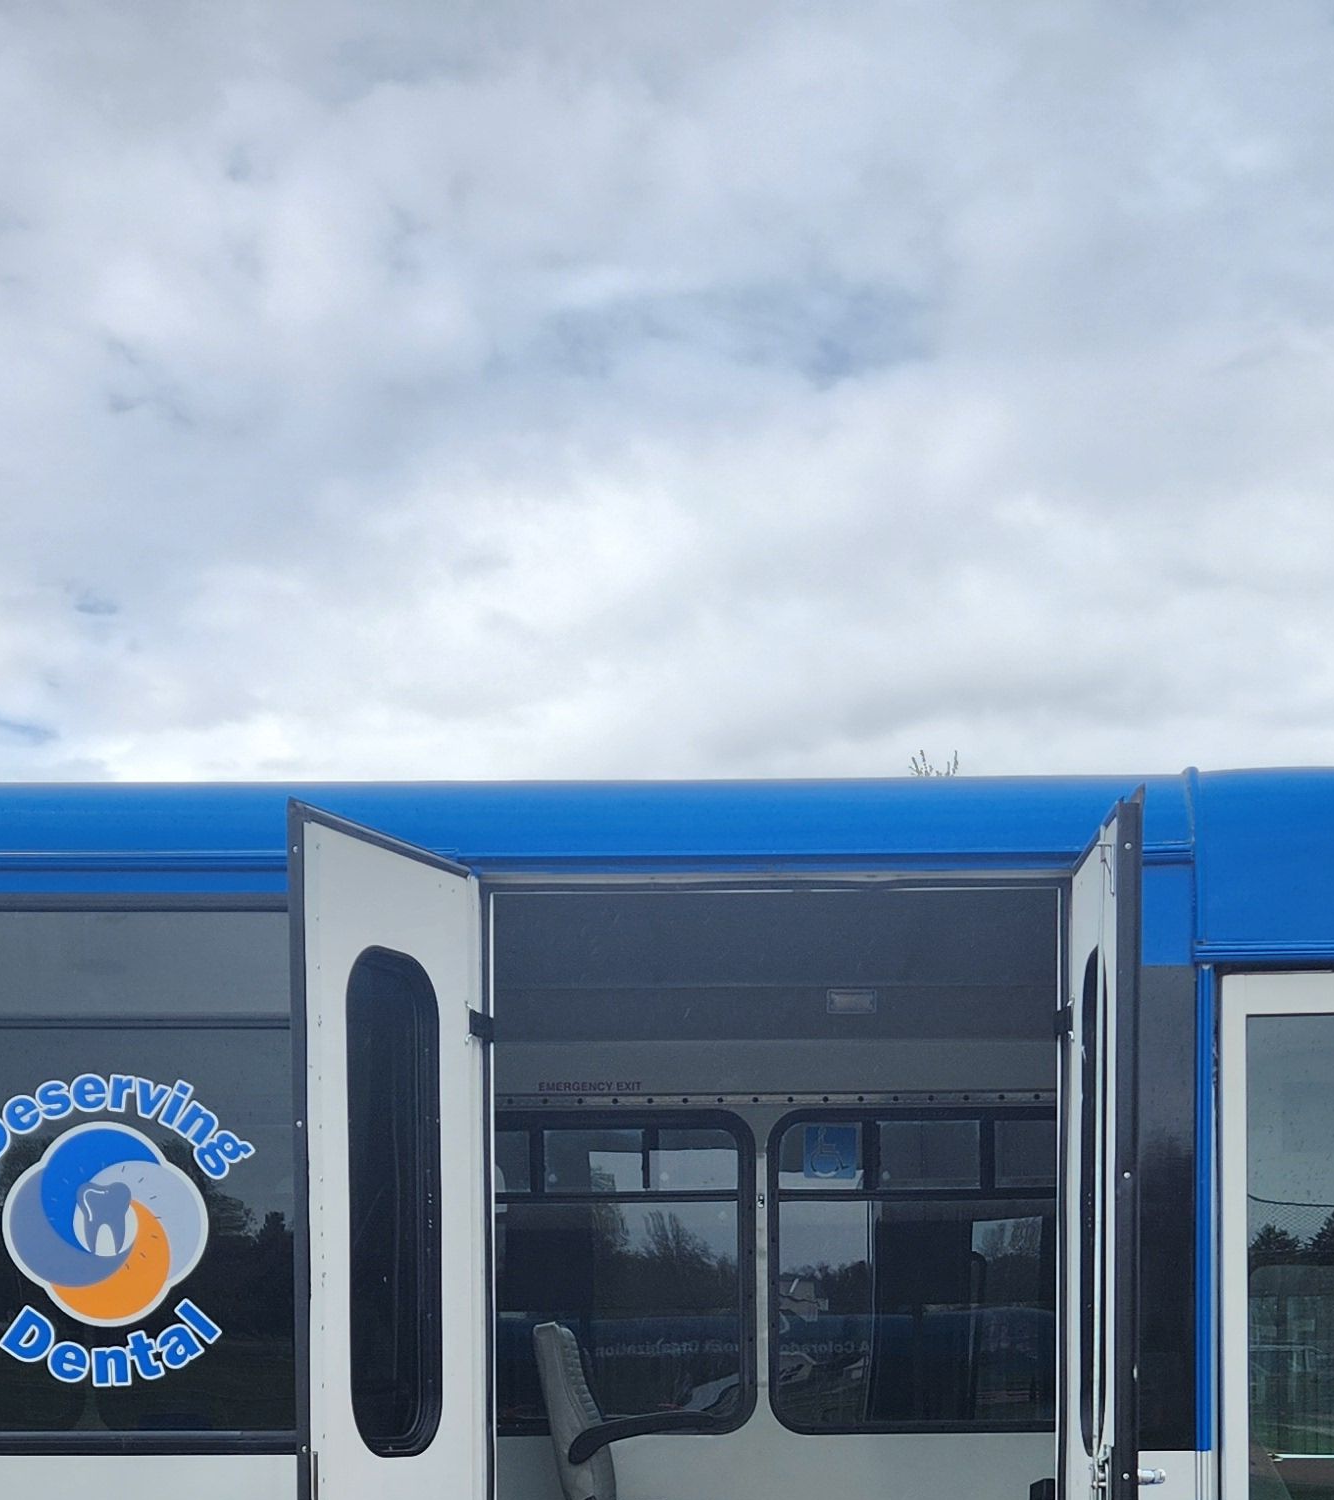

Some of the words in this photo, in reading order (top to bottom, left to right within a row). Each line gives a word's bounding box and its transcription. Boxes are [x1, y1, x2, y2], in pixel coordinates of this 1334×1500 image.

[538, 1081, 613, 1092] EMERGENCY
[616, 1081, 642, 1092] EXIT
[0, 1298, 223, 1387] Dental
